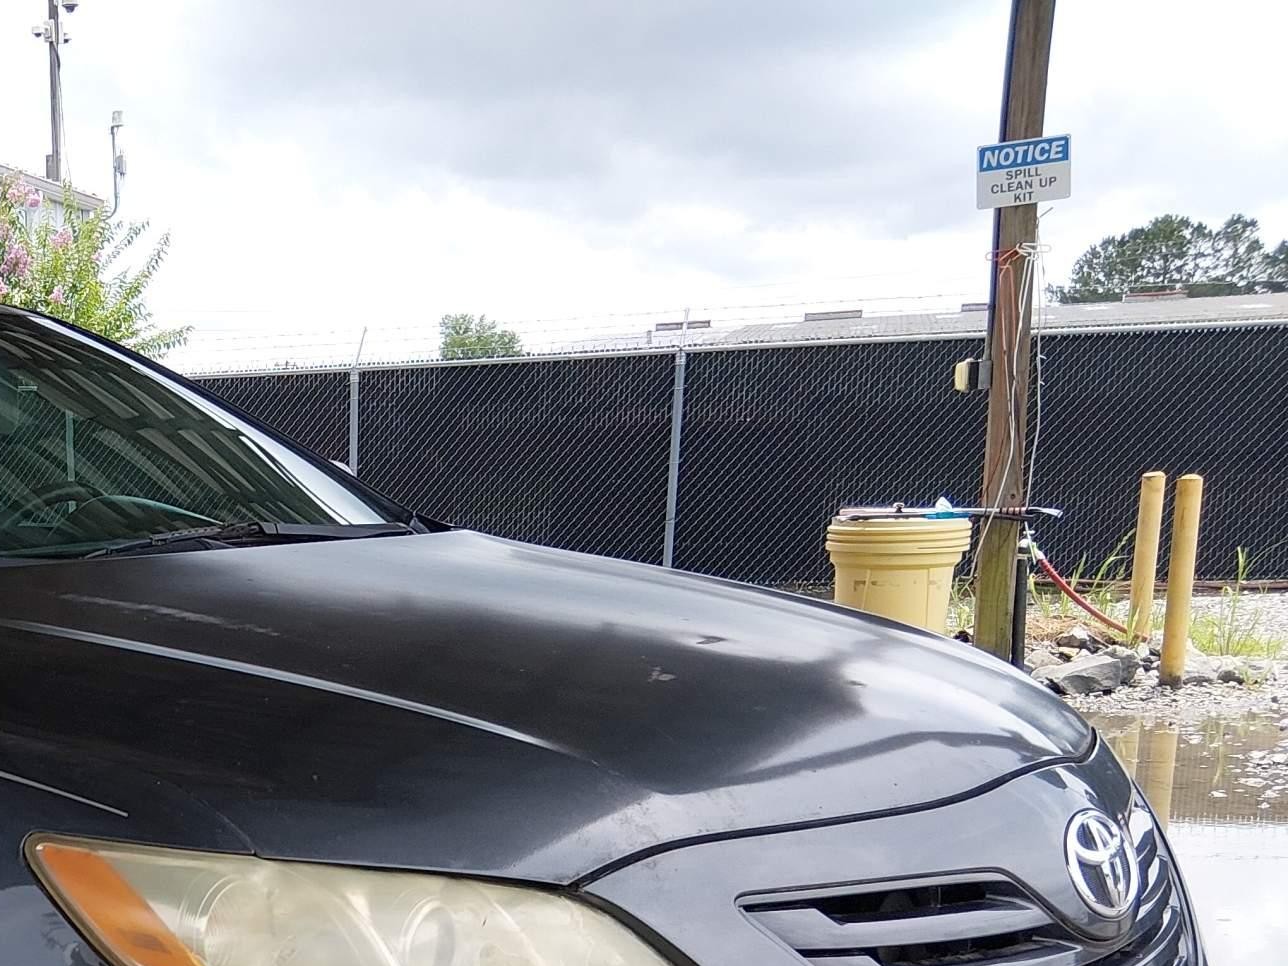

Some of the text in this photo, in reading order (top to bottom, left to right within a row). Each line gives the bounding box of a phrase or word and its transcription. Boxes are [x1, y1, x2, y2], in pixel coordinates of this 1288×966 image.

[982, 140, 1066, 168] NOTICE
[1005, 167, 1042, 181] SPILL
[990, 176, 1057, 194] CLEAN UP
[1014, 191, 1034, 203] KIT
